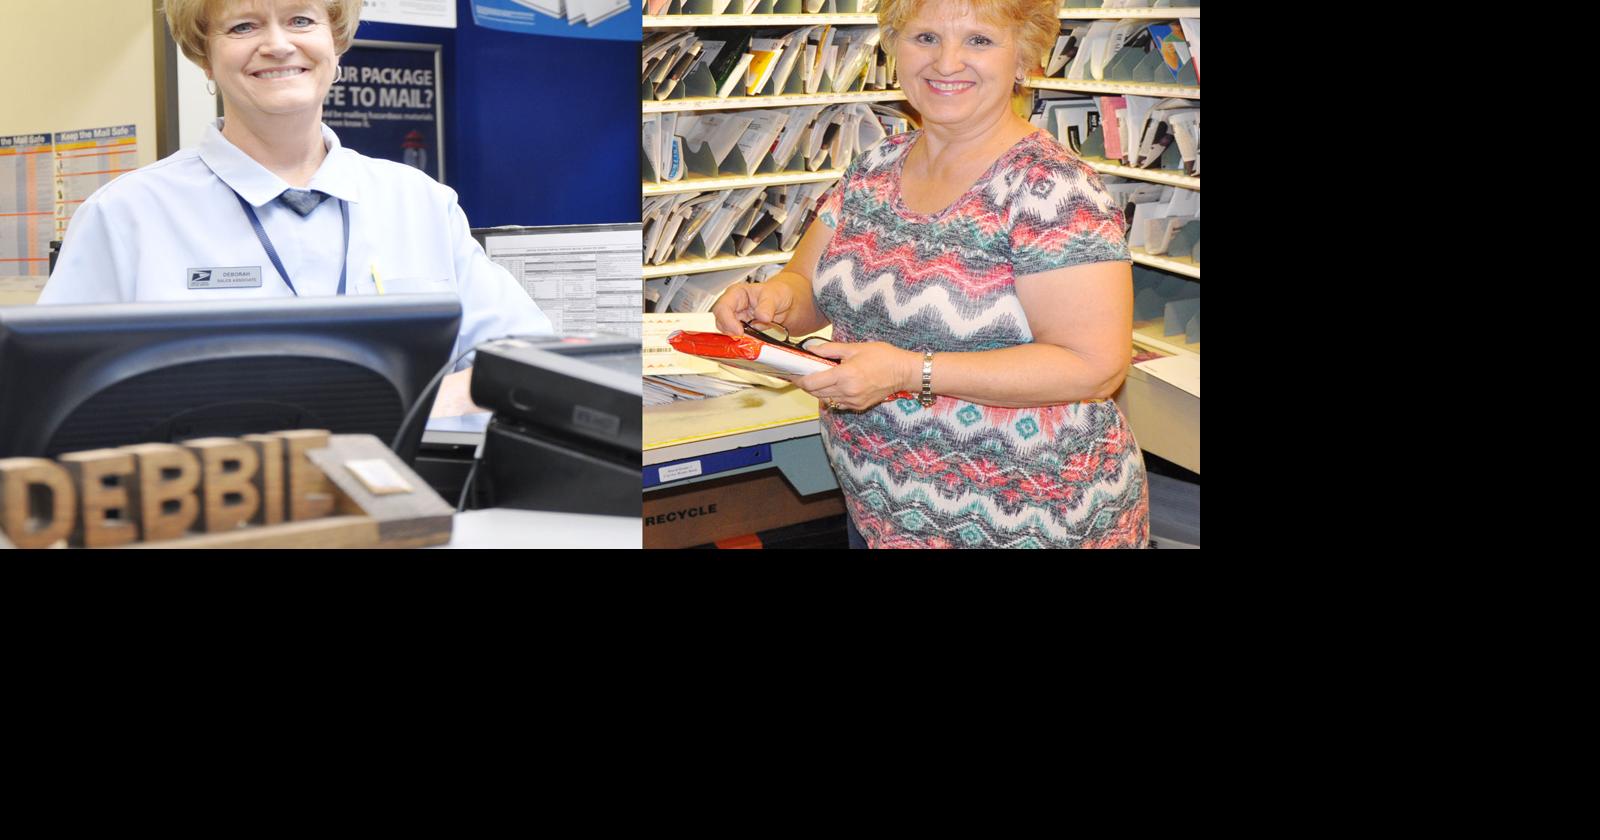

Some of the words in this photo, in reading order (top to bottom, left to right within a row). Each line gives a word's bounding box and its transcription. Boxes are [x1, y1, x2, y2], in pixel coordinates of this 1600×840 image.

[361, 67, 433, 85] PACKAGE
[349, 86, 376, 107] TO
[380, 88, 433, 108] MAIL?
[0, 137, 12, 146] the
[13, 136, 28, 145] Mail
[29, 135, 45, 144] Safe
[62, 132, 79, 142] Keep
[79, 130, 92, 139] the
[93, 129, 111, 138] Mail
[111, 127, 129, 136] Safe
[645, 504, 717, 526] RECYCLE
